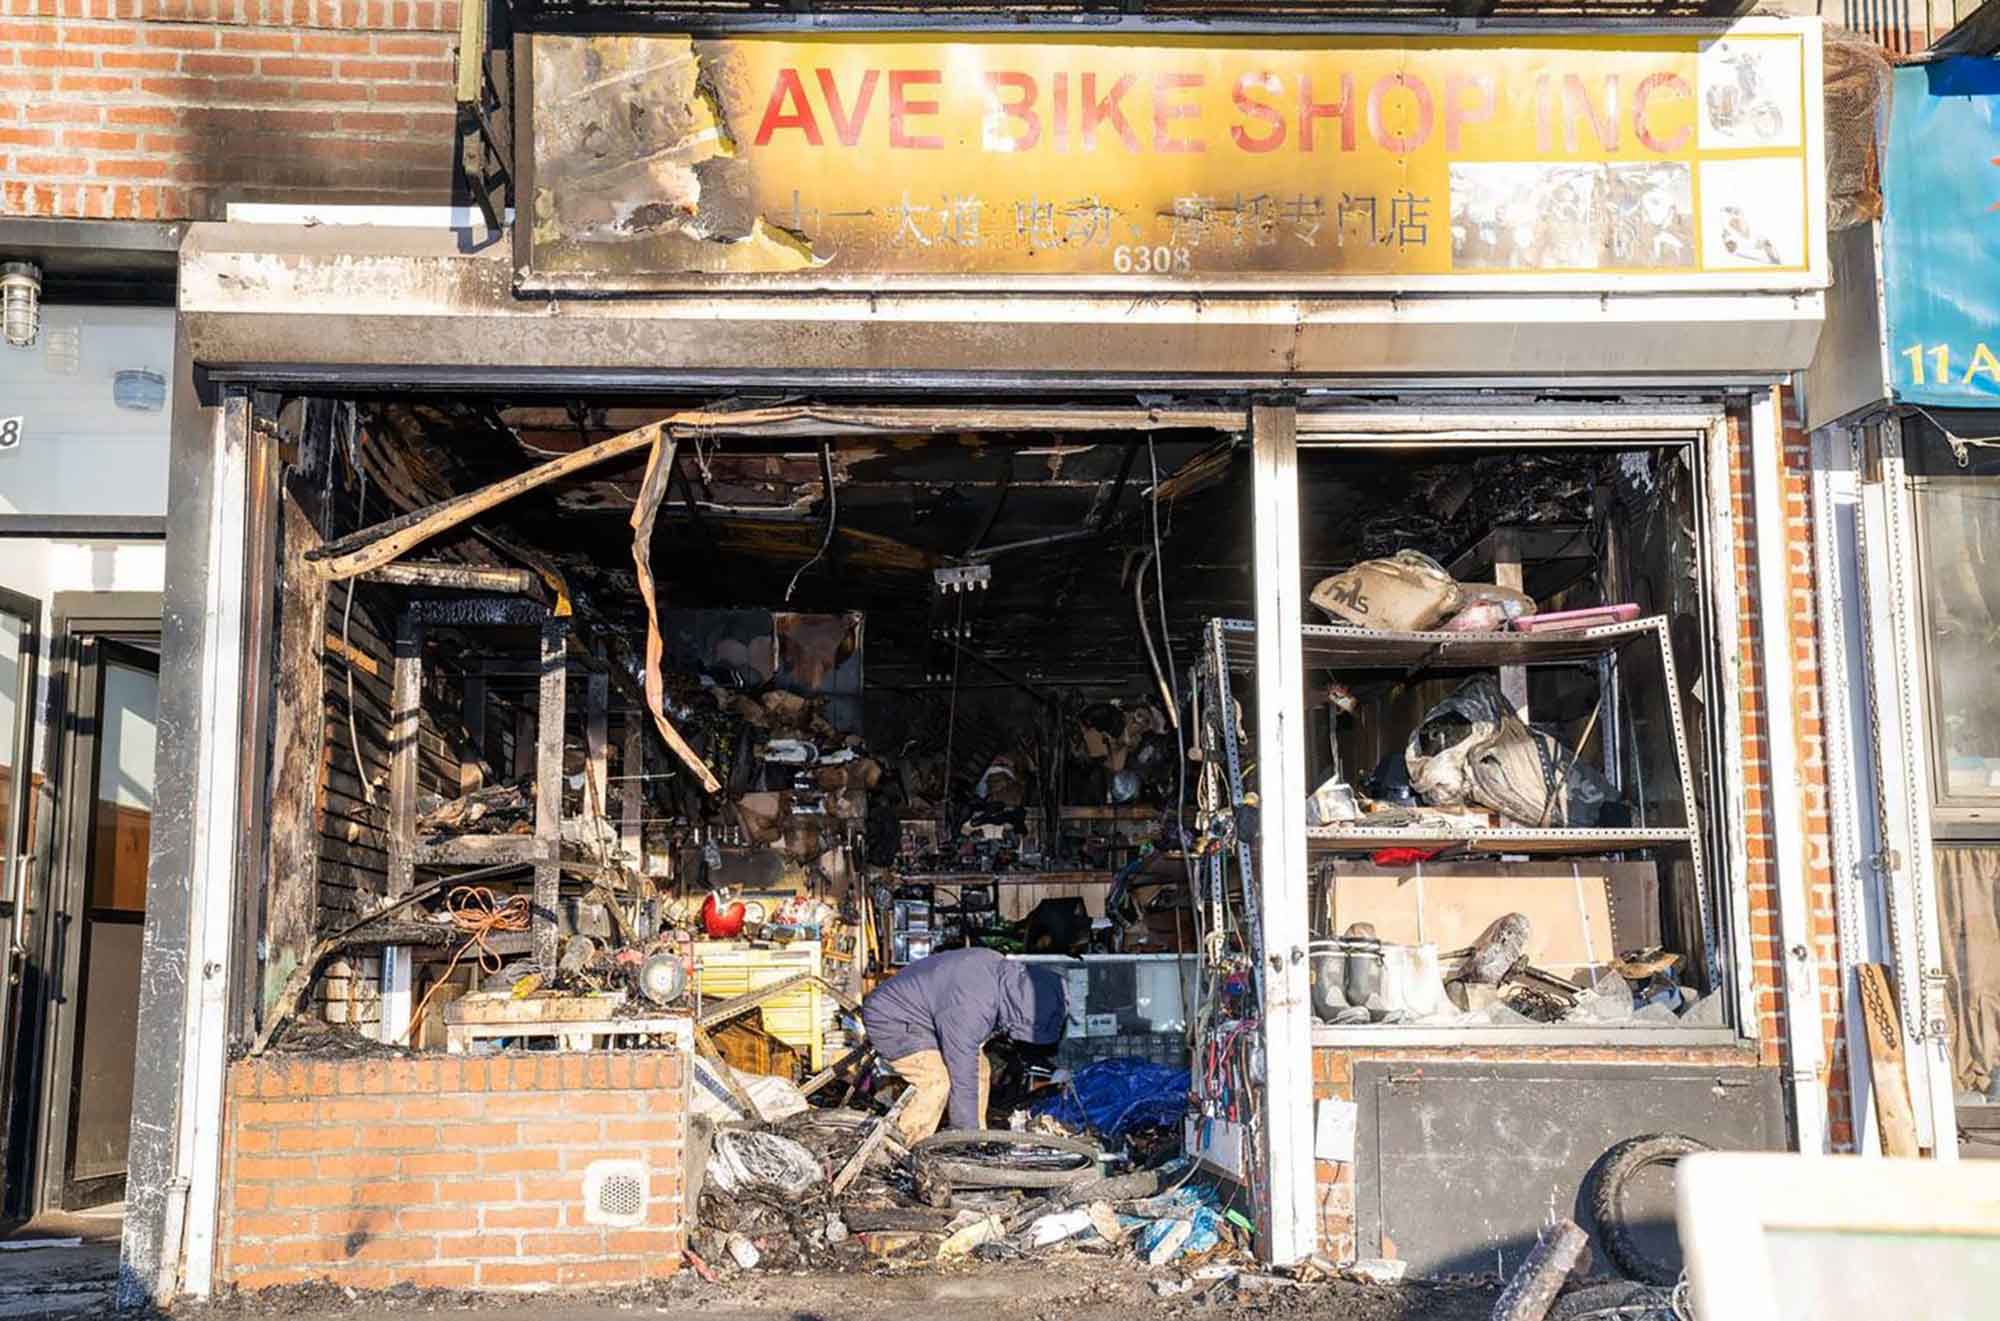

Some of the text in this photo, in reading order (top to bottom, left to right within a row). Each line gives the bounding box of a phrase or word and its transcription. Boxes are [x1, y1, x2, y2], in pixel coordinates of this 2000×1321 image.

[754, 68, 1692, 154] AVE BIKE SHOP INC
[1113, 244, 1192, 274] 6308
[1902, 343, 1949, 385] 11
